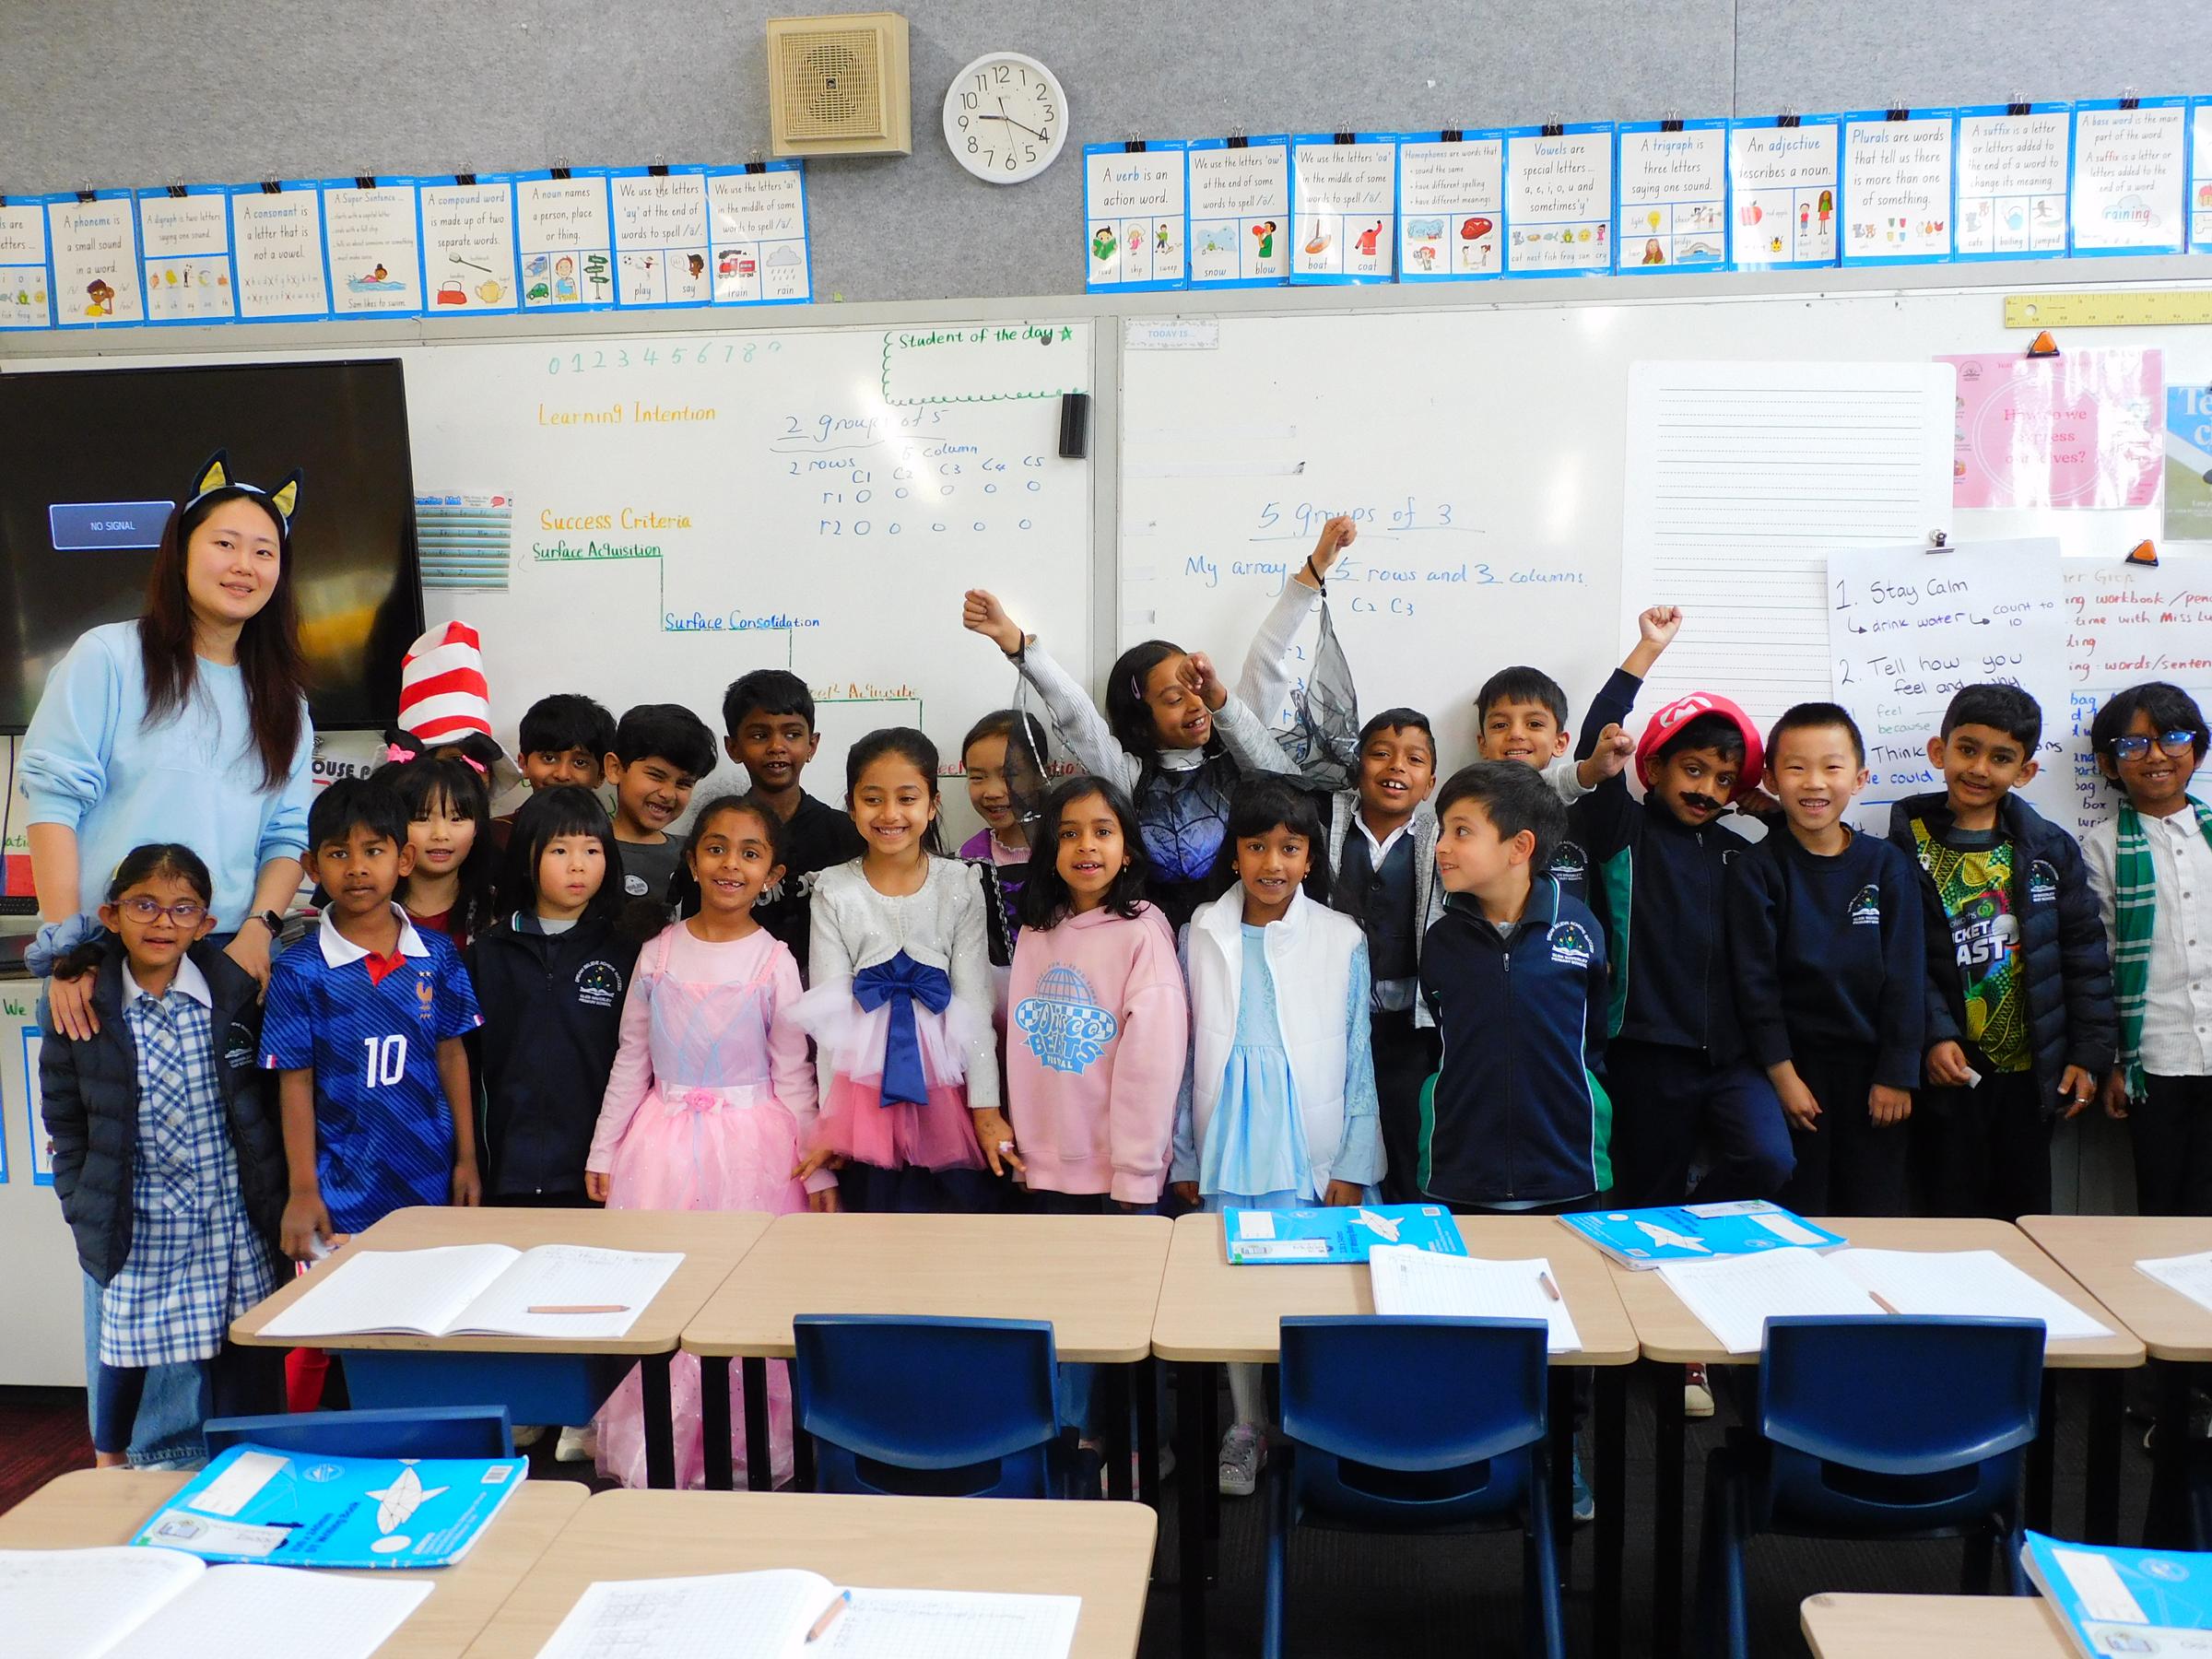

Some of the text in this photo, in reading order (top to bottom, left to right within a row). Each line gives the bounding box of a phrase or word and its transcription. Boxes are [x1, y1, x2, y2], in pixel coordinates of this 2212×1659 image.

[975, 75, 987, 91] 11
[992, 66, 1010, 84] 12
[1019, 69, 1026, 86] 1
[1036, 83, 1047, 100] 2
[960, 92, 977, 110] 10
[1043, 105, 1053, 122] 3
[958, 115, 969, 132] 9
[1039, 127, 1050, 144] 4
[1853, 127, 1944, 144] Plurals are words
[968, 136, 978, 153] 8
[1535, 143, 1584, 156] Vowels are
[1641, 136, 1703, 157] A trigraph is
[1747, 135, 1820, 159] An adjective
[982, 150, 994, 167] 7
[1006, 153, 1016, 170] 6
[1026, 146, 1036, 162] 5
[1854, 147, 1940, 165] that tell us there
[1103, 167, 1168, 182] A verb is an
[1524, 160, 1586, 182] special letters
[1644, 158, 1700, 174] three letters
[1801, 166, 1830, 176] noun.
[1854, 170, 1940, 185] is more than one
[533, 188, 539, 199] A
[543, 191, 561, 199] noun
[1632, 177, 1712, 199] saying one sound.
[1104, 189, 1168, 206] action word.
[1863, 188, 1931, 210] of something.
[541, 210, 569, 225] person,
[571, 207, 593, 223] place
[2105, 206, 2151, 226] raining
[547, 229, 580, 244] or thing.
[1204, 268, 1226, 276] snow
[1255, 263, 1276, 275] blow
[1308, 257, 1327, 270] boat
[1359, 261, 1377, 271] coat
[635, 284, 651, 300] play
[683, 286, 696, 298] say
[900, 325, 1053, 348] Student of the day
[549, 358, 560, 374] 0
[571, 354, 584, 372] 1
[592, 350, 606, 368] 2
[618, 350, 629, 368] 3
[644, 347, 658, 366] 4
[672, 348, 688, 364] 5
[698, 341, 712, 363] 6
[723, 345, 734, 363] 7
[743, 343, 756, 363] 8
[538, 402, 715, 425] Learning Intention
[786, 417, 802, 432] 2
[901, 406, 923, 427] of
[932, 410, 949, 423] 5
[2065, 410, 2087, 419] we
[790, 457, 855, 475] 2 rows
[853, 470, 870, 483] C1
[541, 508, 691, 531] Success Criteria
[1258, 501, 1280, 528] 5
[1394, 496, 1415, 528] of
[1439, 504, 1451, 525] 3
[90, 521, 135, 531] NO SIGNAL
[820, 520, 841, 535] r2
[533, 540, 661, 559] Surface Acquisition
[1186, 555, 1218, 588] My
[1232, 560, 1286, 596] array
[1335, 557, 1362, 580] 5
[1368, 569, 1416, 582] rows
[1427, 564, 1467, 582] and
[1475, 564, 1495, 582] 3
[1837, 578, 1968, 609] 1. Stay Calm
[1392, 598, 1413, 616] C3
[1993, 603, 2031, 614] count
[665, 610, 819, 629] Surface Consolidation
[1873, 612, 1965, 633] drink water
[2009, 618, 2022, 627] 10
[2119, 612, 2150, 624] with
[2160, 612, 2192, 623] Miss
[1840, 653, 2022, 685] 2. Tell how you
[1894, 680, 1926, 695] feel
[1936, 678, 1965, 693] and
[1877, 706, 1901, 716] feel
[2071, 692, 2096, 713] bag
[1878, 721, 1931, 734] because
[1872, 746, 1925, 764] Think
[1890, 770, 1933, 783] could
[2083, 797, 2107, 809] box
[1957, 934, 2009, 967] AST
[3, 998, 27, 1017] We
[1030, 1032, 1100, 1064] BEATS
[364, 1034, 407, 1088] 10
